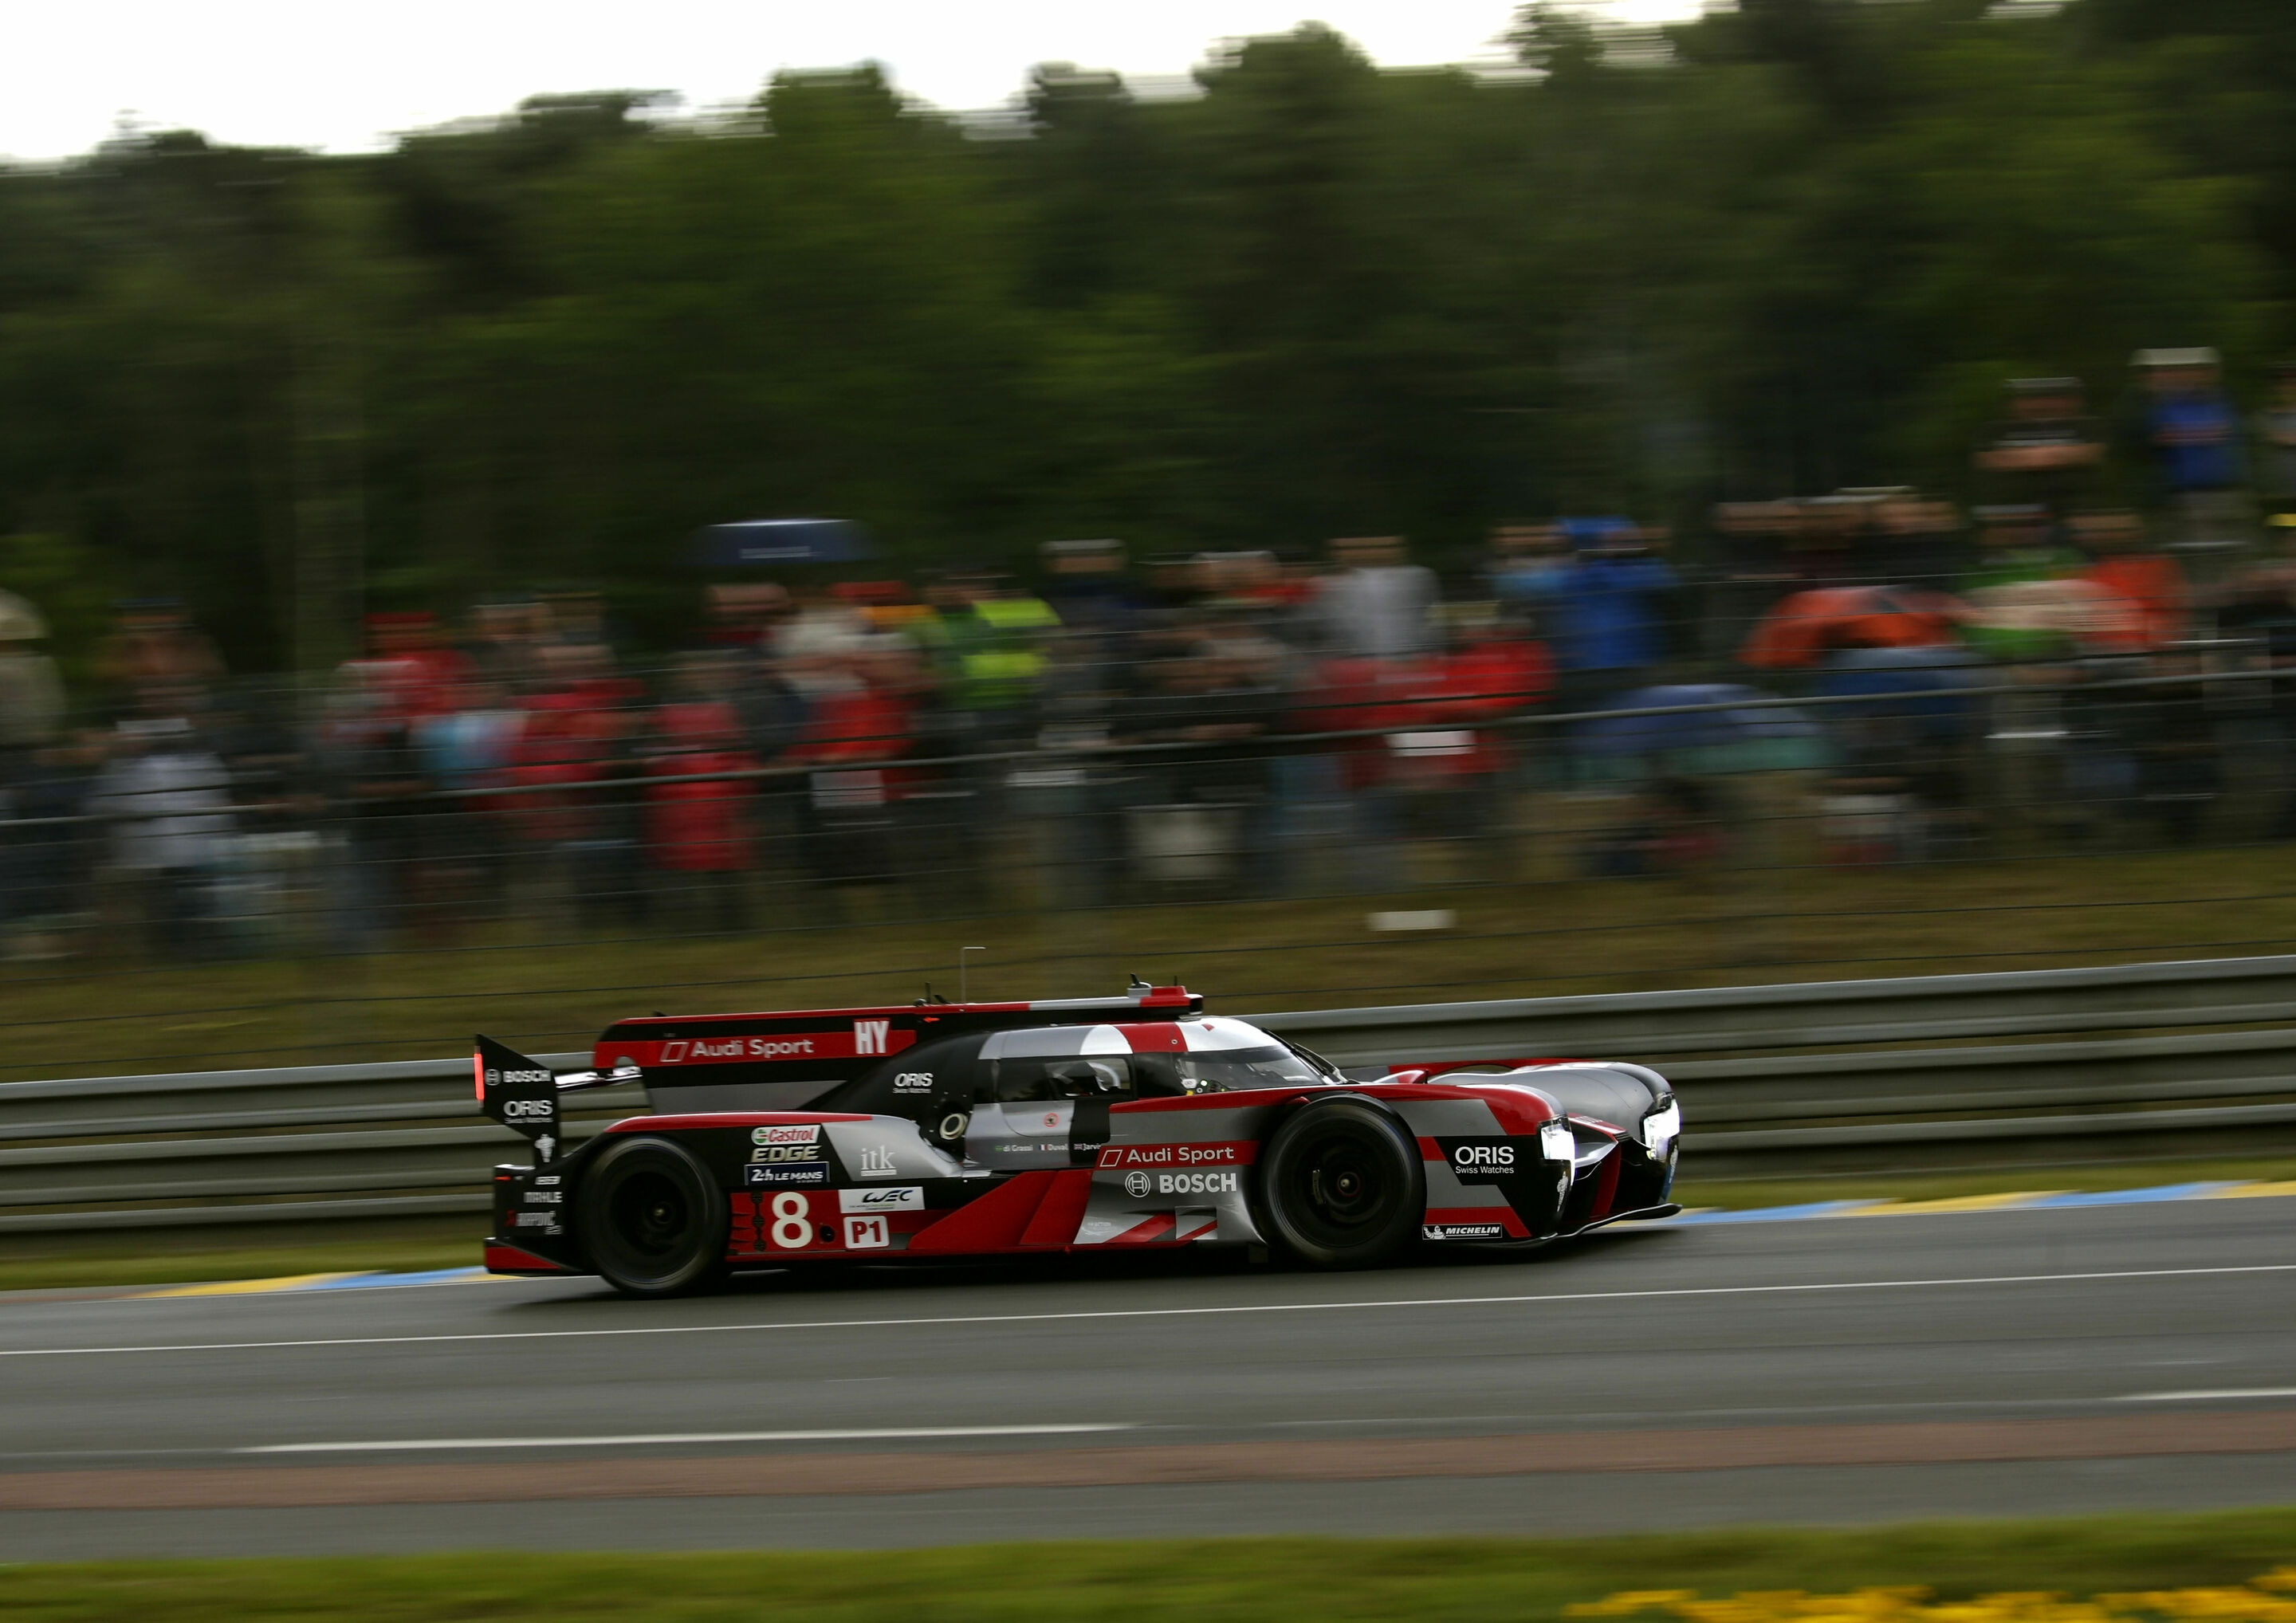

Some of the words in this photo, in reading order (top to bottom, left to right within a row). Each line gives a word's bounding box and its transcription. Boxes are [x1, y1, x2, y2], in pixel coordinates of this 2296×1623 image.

[854, 1020, 890, 1054] HY
[690, 1040, 744, 1057] Audi
[749, 1039, 815, 1058] Sport
[502, 1070, 551, 1083] BOSCH
[894, 1072, 934, 1087] ORIS
[503, 1100, 553, 1116] ORIS
[769, 1128, 815, 1142] Castrol
[751, 1145, 822, 1162] EDGE
[861, 1145, 896, 1170] itk
[1126, 1147, 1172, 1163] Audi
[1178, 1146, 1234, 1165] Sport
[1455, 1146, 1515, 1165] ORIS
[789, 1171, 824, 1181] MANS
[1159, 1173, 1236, 1193] BOSCH
[862, 1189, 914, 1203] WEC
[771, 1191, 813, 1248] 8
[851, 1220, 882, 1244] P1
[1445, 1226, 1500, 1235] MICHELIN
